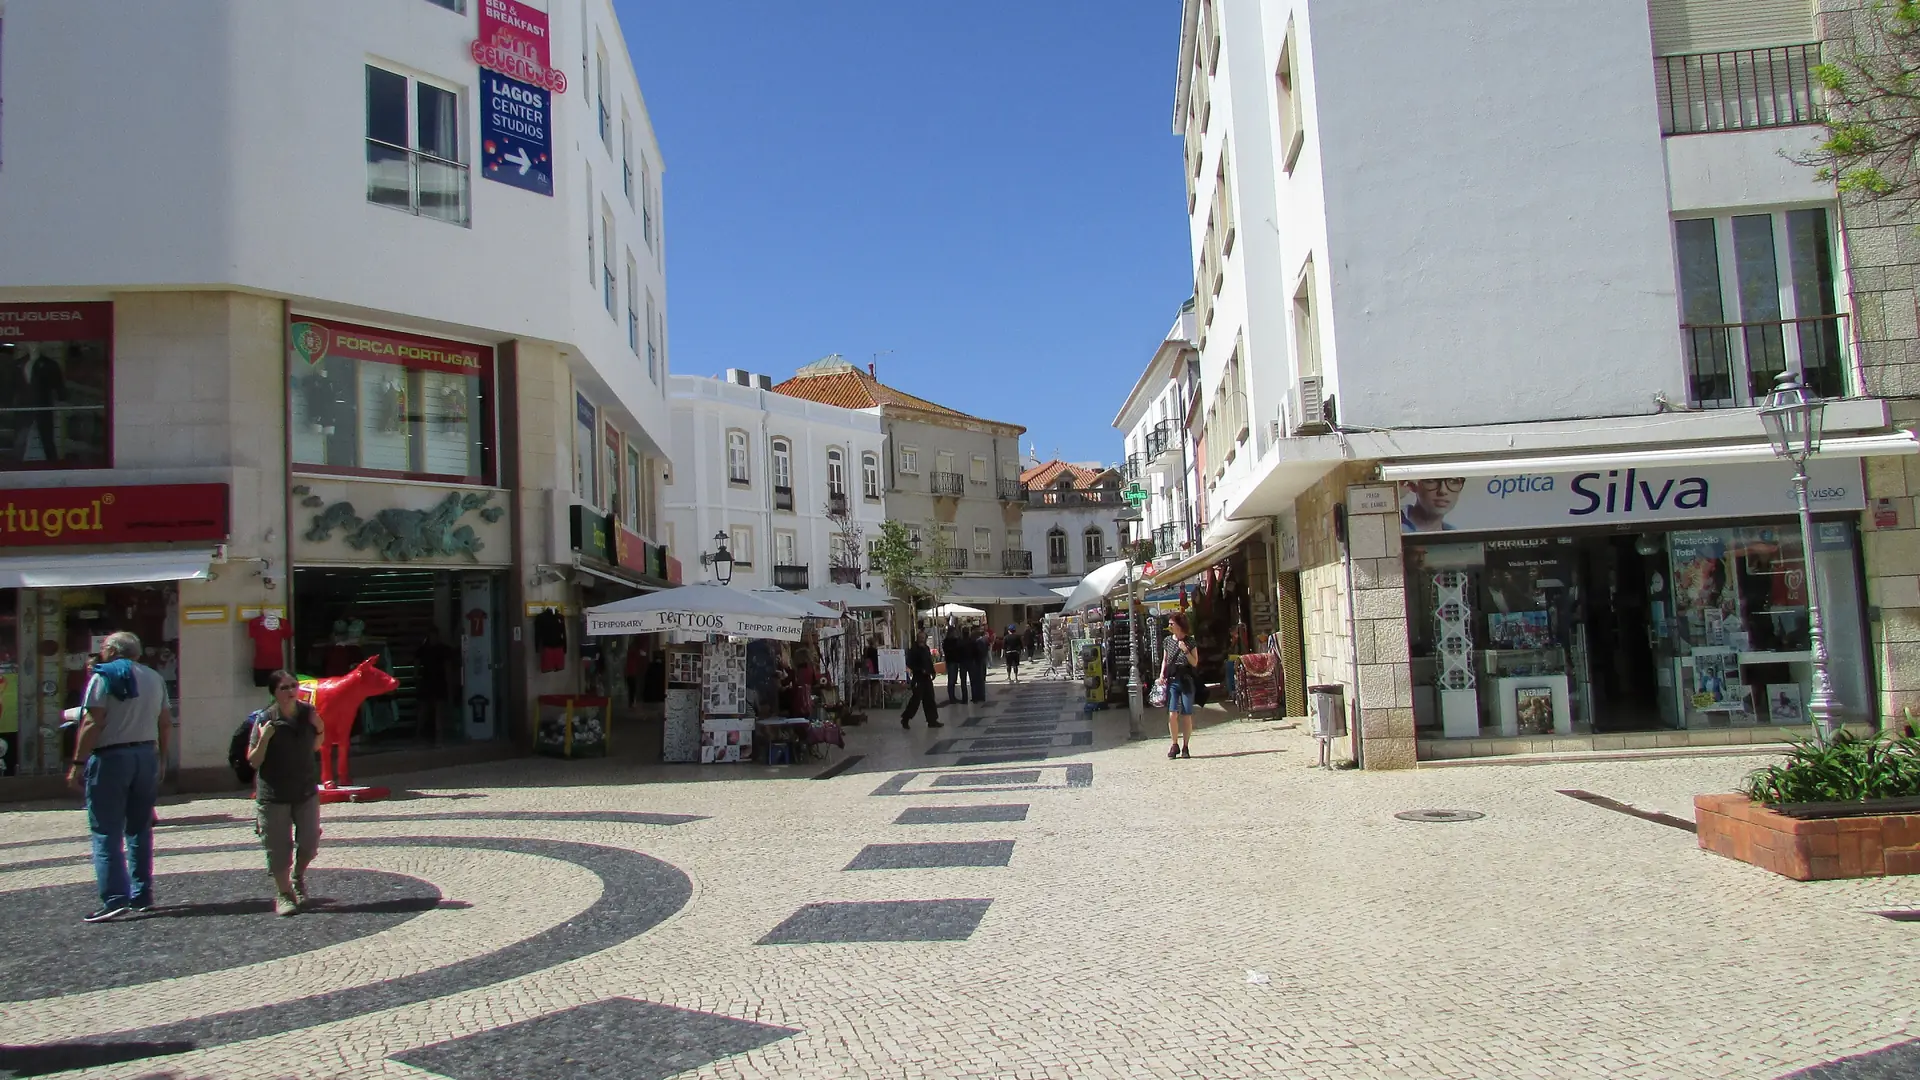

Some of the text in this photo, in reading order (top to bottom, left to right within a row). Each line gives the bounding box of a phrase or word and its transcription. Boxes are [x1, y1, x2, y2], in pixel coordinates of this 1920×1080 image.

[486, 0, 518, 17] BED &
[486, 8, 545, 37] BREAKFAST
[492, 79, 543, 108] LAGOS
[492, 97, 543, 124] CENTER
[492, 114, 544, 140] STUDIOS
[336, 335, 482, 369] FORÇA PORTUGAL
[1487, 468, 1709, 515] óptica Silva
